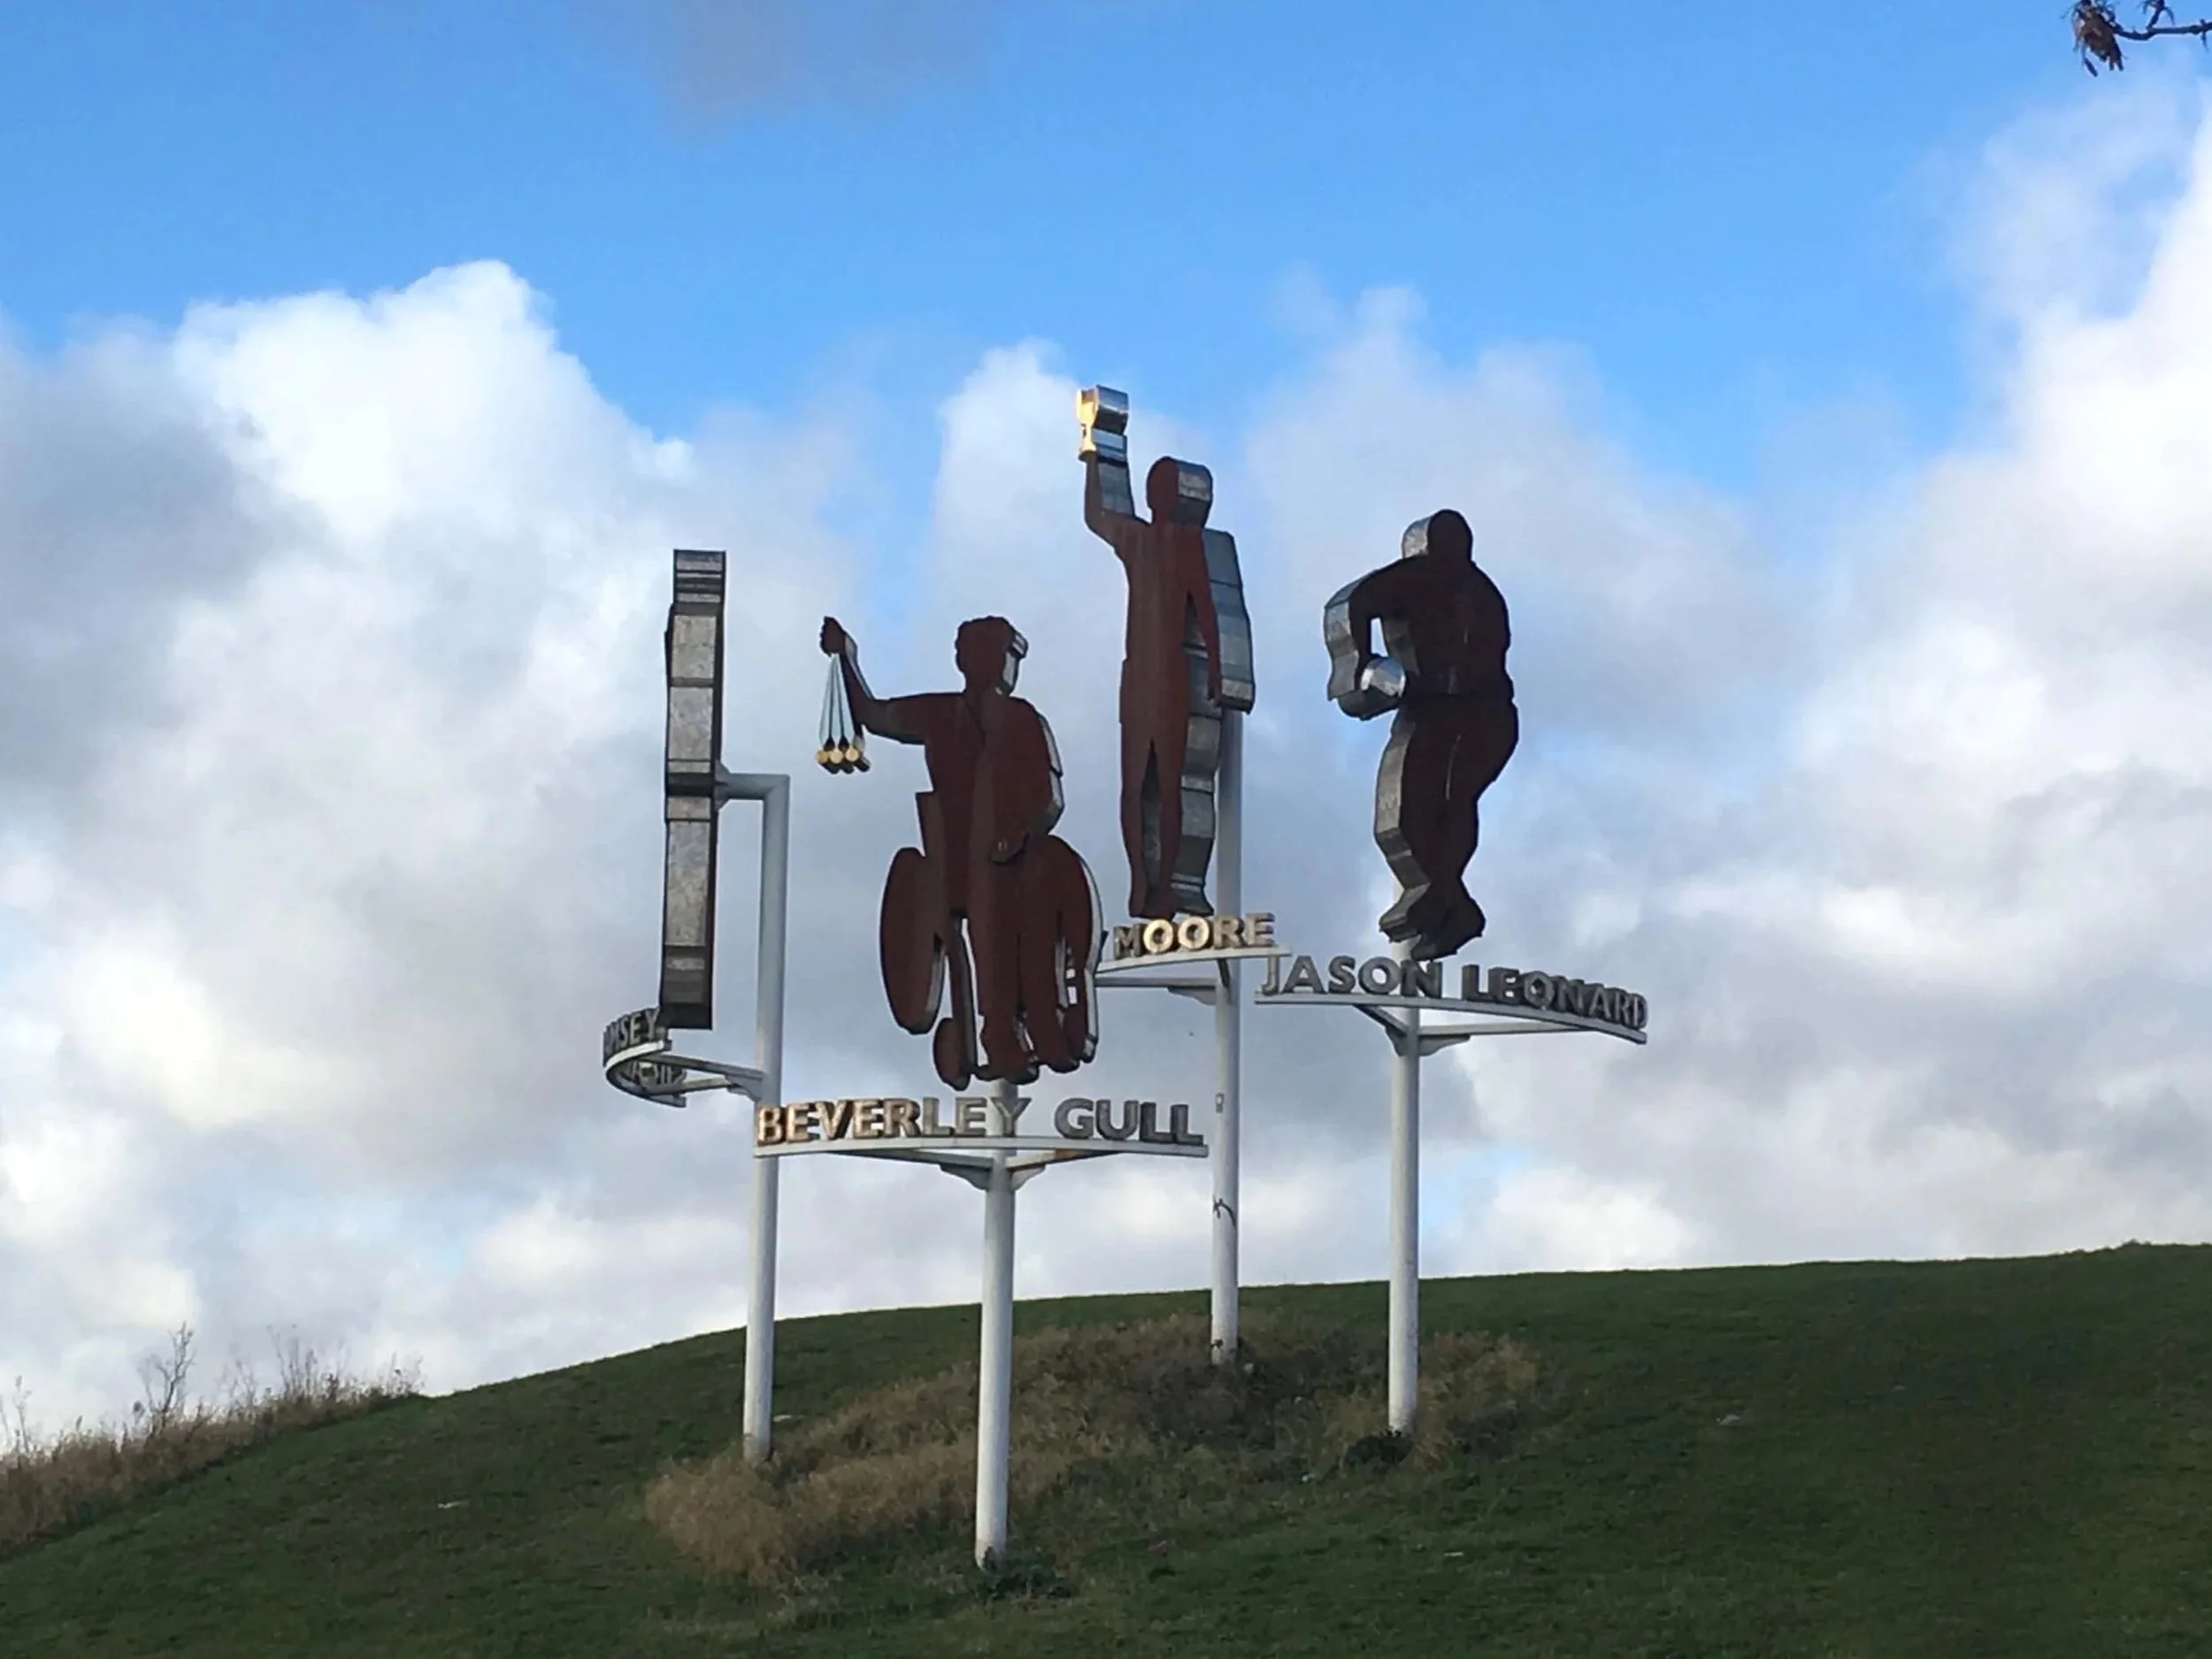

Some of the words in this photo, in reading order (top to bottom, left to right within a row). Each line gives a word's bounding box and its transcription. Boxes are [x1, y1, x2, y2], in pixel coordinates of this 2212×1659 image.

[1112, 912, 1275, 960] MOORE
[1260, 955, 1443, 999] JASON
[1462, 964, 1648, 1030] LEONARD
[756, 1096, 1033, 1147] BEVERLEY
[1054, 1097, 1204, 1144] GULL
